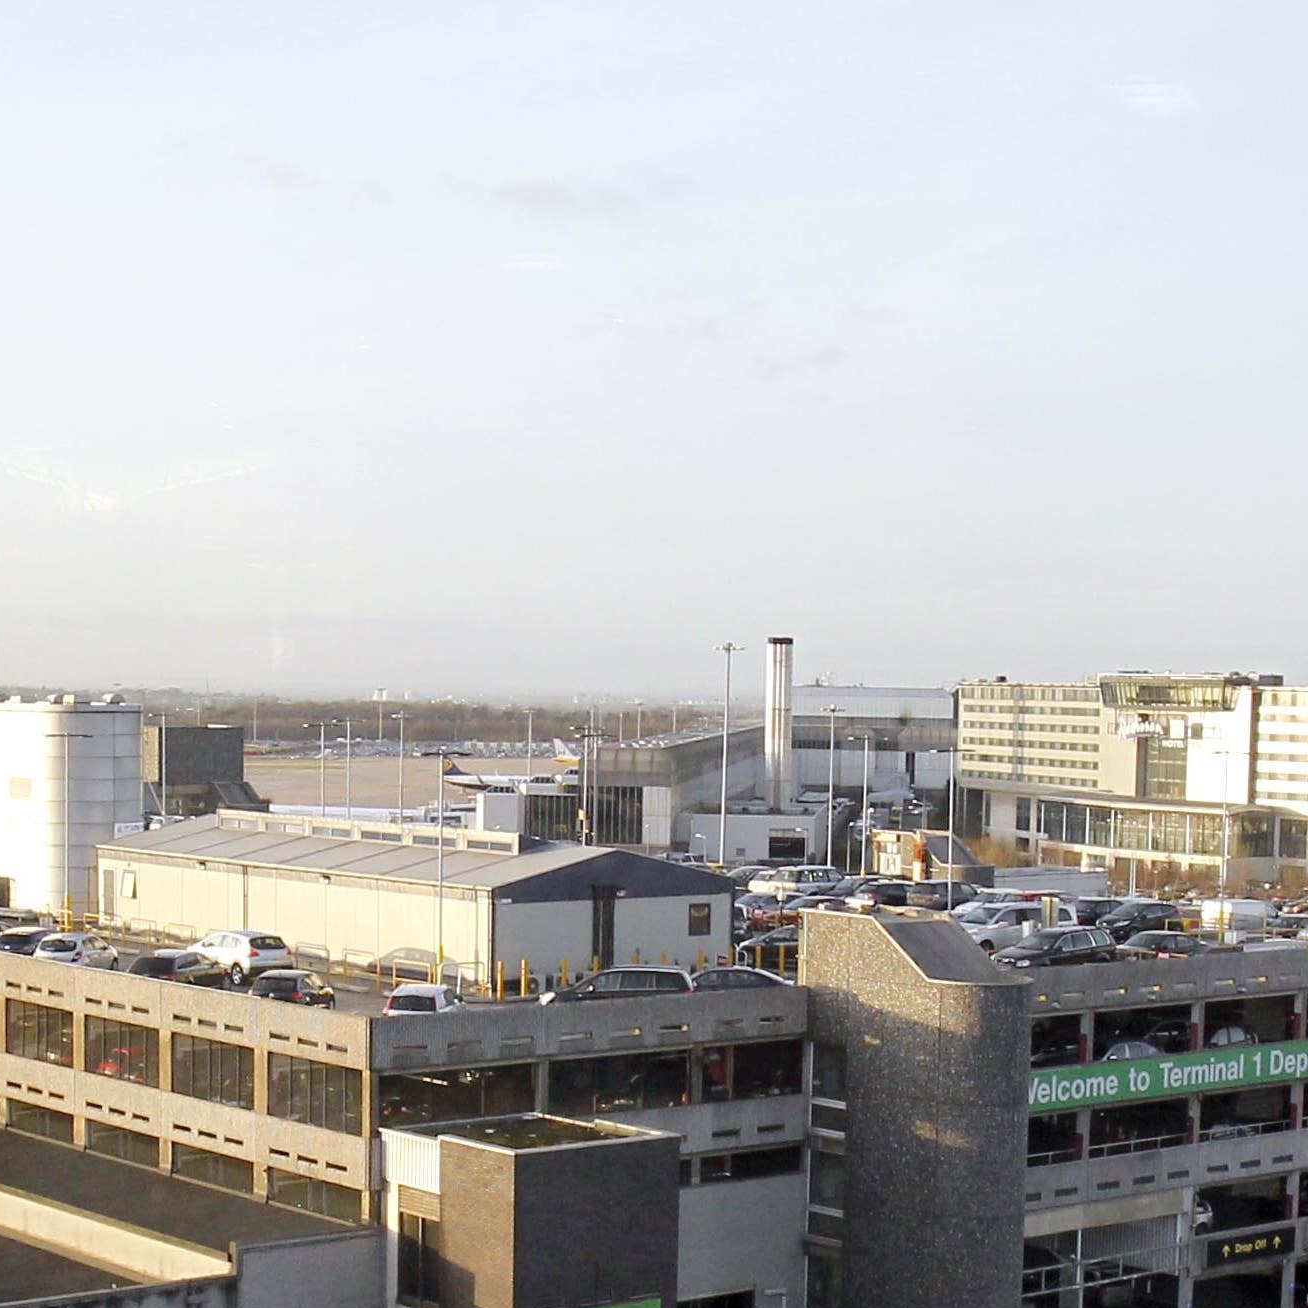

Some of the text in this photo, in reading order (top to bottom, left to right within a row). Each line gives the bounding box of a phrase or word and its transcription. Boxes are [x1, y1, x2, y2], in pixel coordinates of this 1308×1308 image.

[1128, 1067, 1151, 1093] to
[1159, 1055, 1244, 1088] Terminal
[1252, 1053, 1262, 1077] 1
[1234, 1239, 1267, 1254] Drop Off
